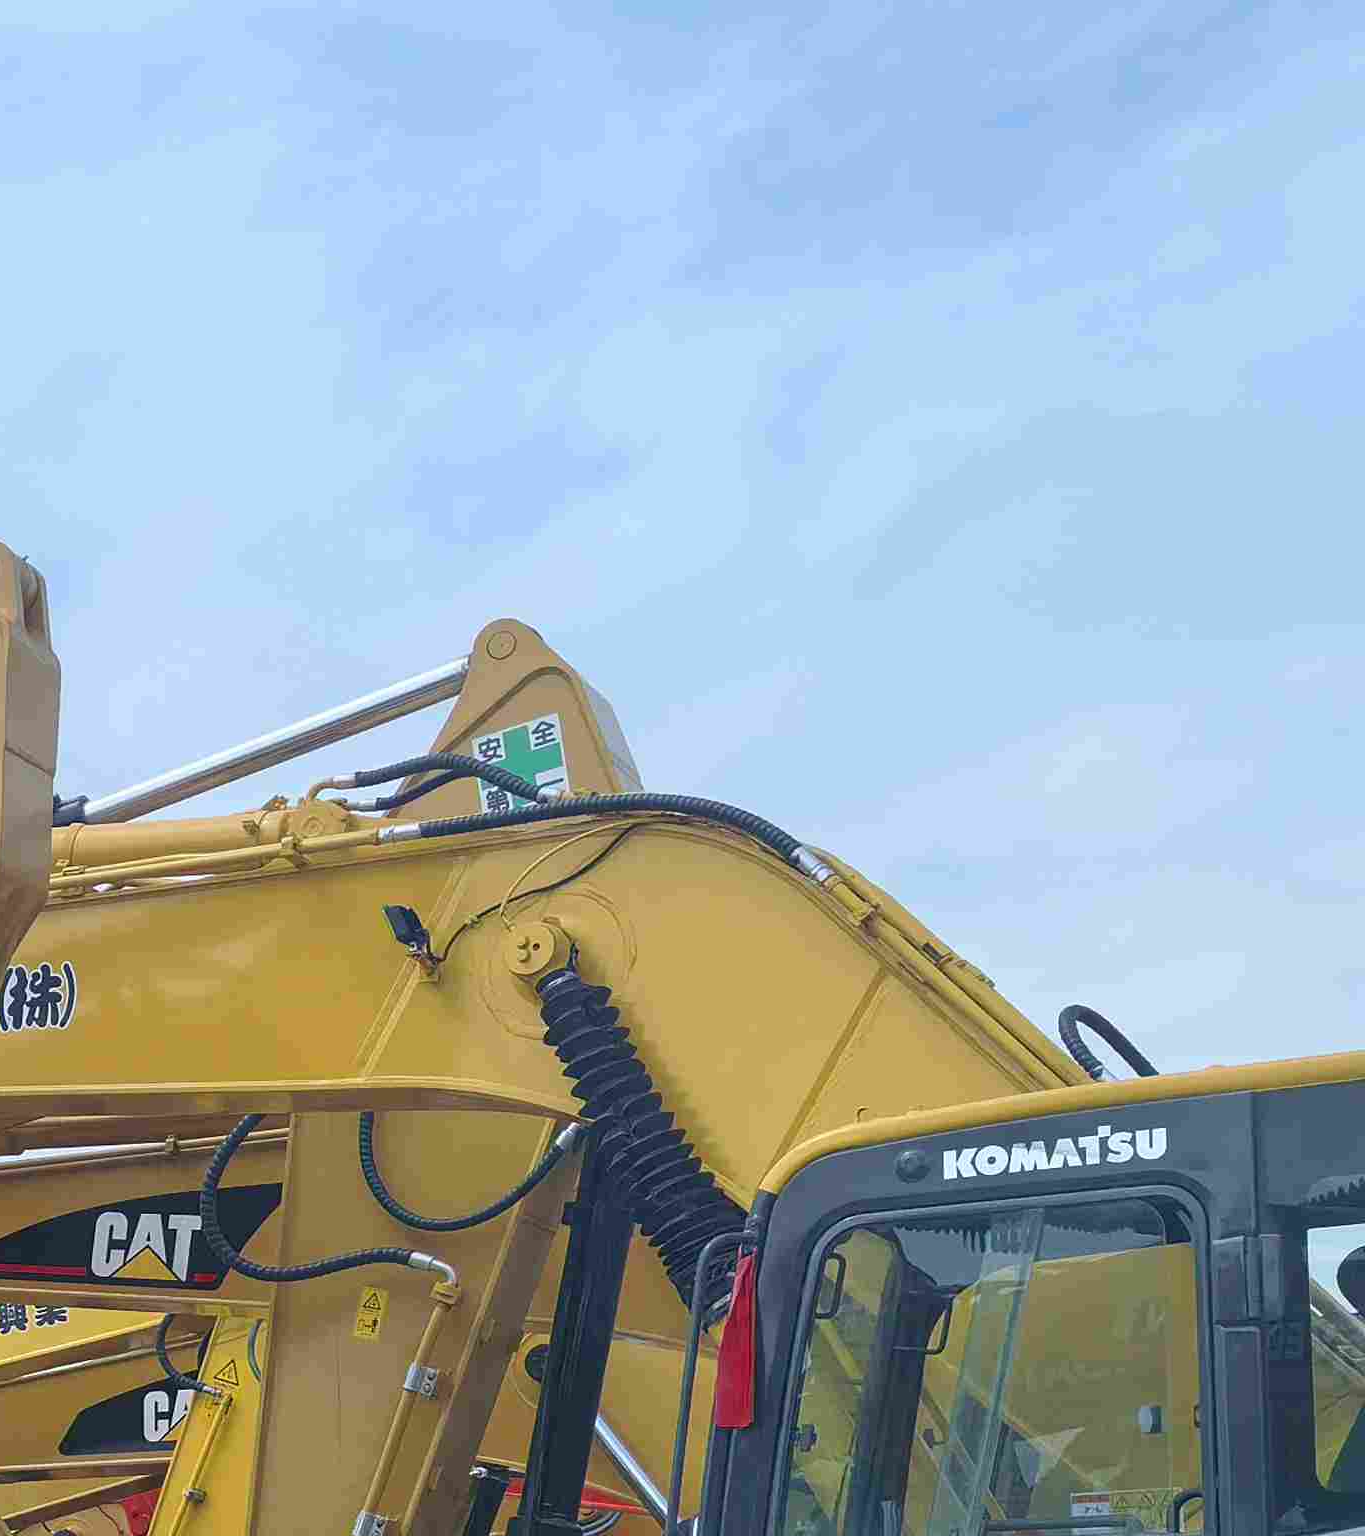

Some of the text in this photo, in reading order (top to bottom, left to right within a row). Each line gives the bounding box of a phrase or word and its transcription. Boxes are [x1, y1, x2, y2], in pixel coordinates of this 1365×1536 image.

[943, 1125, 1167, 1180] KOMATSU
[91, 1211, 203, 1282] CAT
[143, 1388, 195, 1442] CA
